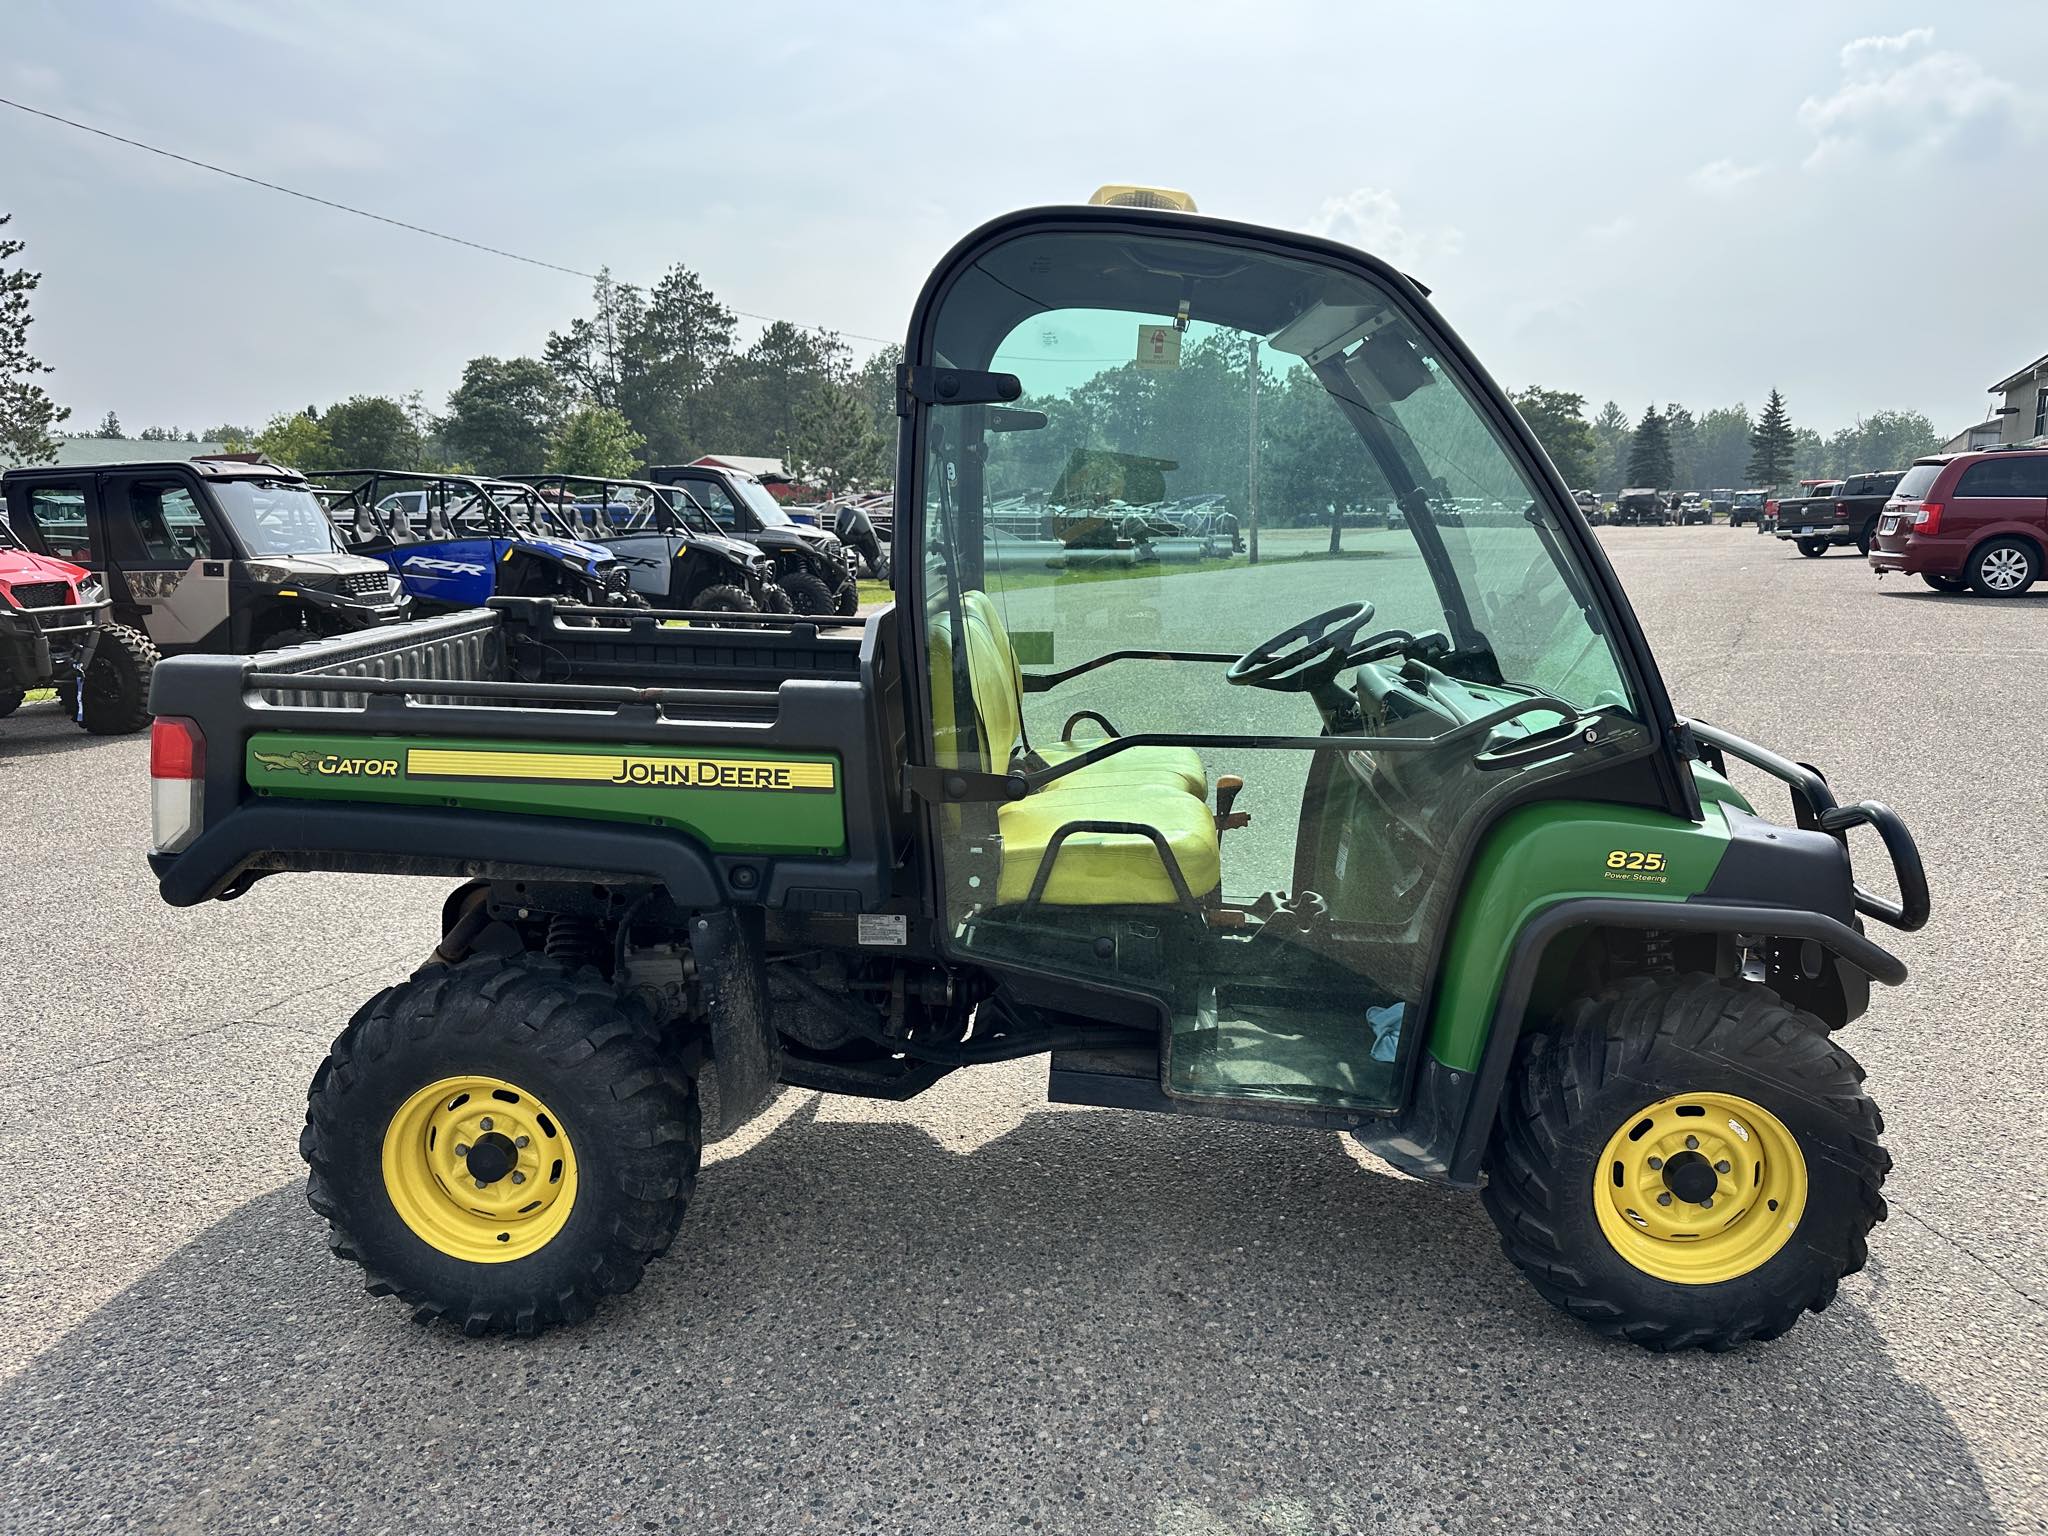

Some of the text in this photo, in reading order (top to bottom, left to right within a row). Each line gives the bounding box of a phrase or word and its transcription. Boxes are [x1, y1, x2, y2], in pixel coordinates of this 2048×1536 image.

[401, 555, 487, 577] RZR
[317, 755, 399, 775] GATOR
[612, 759, 792, 787] JOHN DEERE
[1606, 850, 1667, 871] 825i
[1604, 871, 1668, 883] Power Steering
